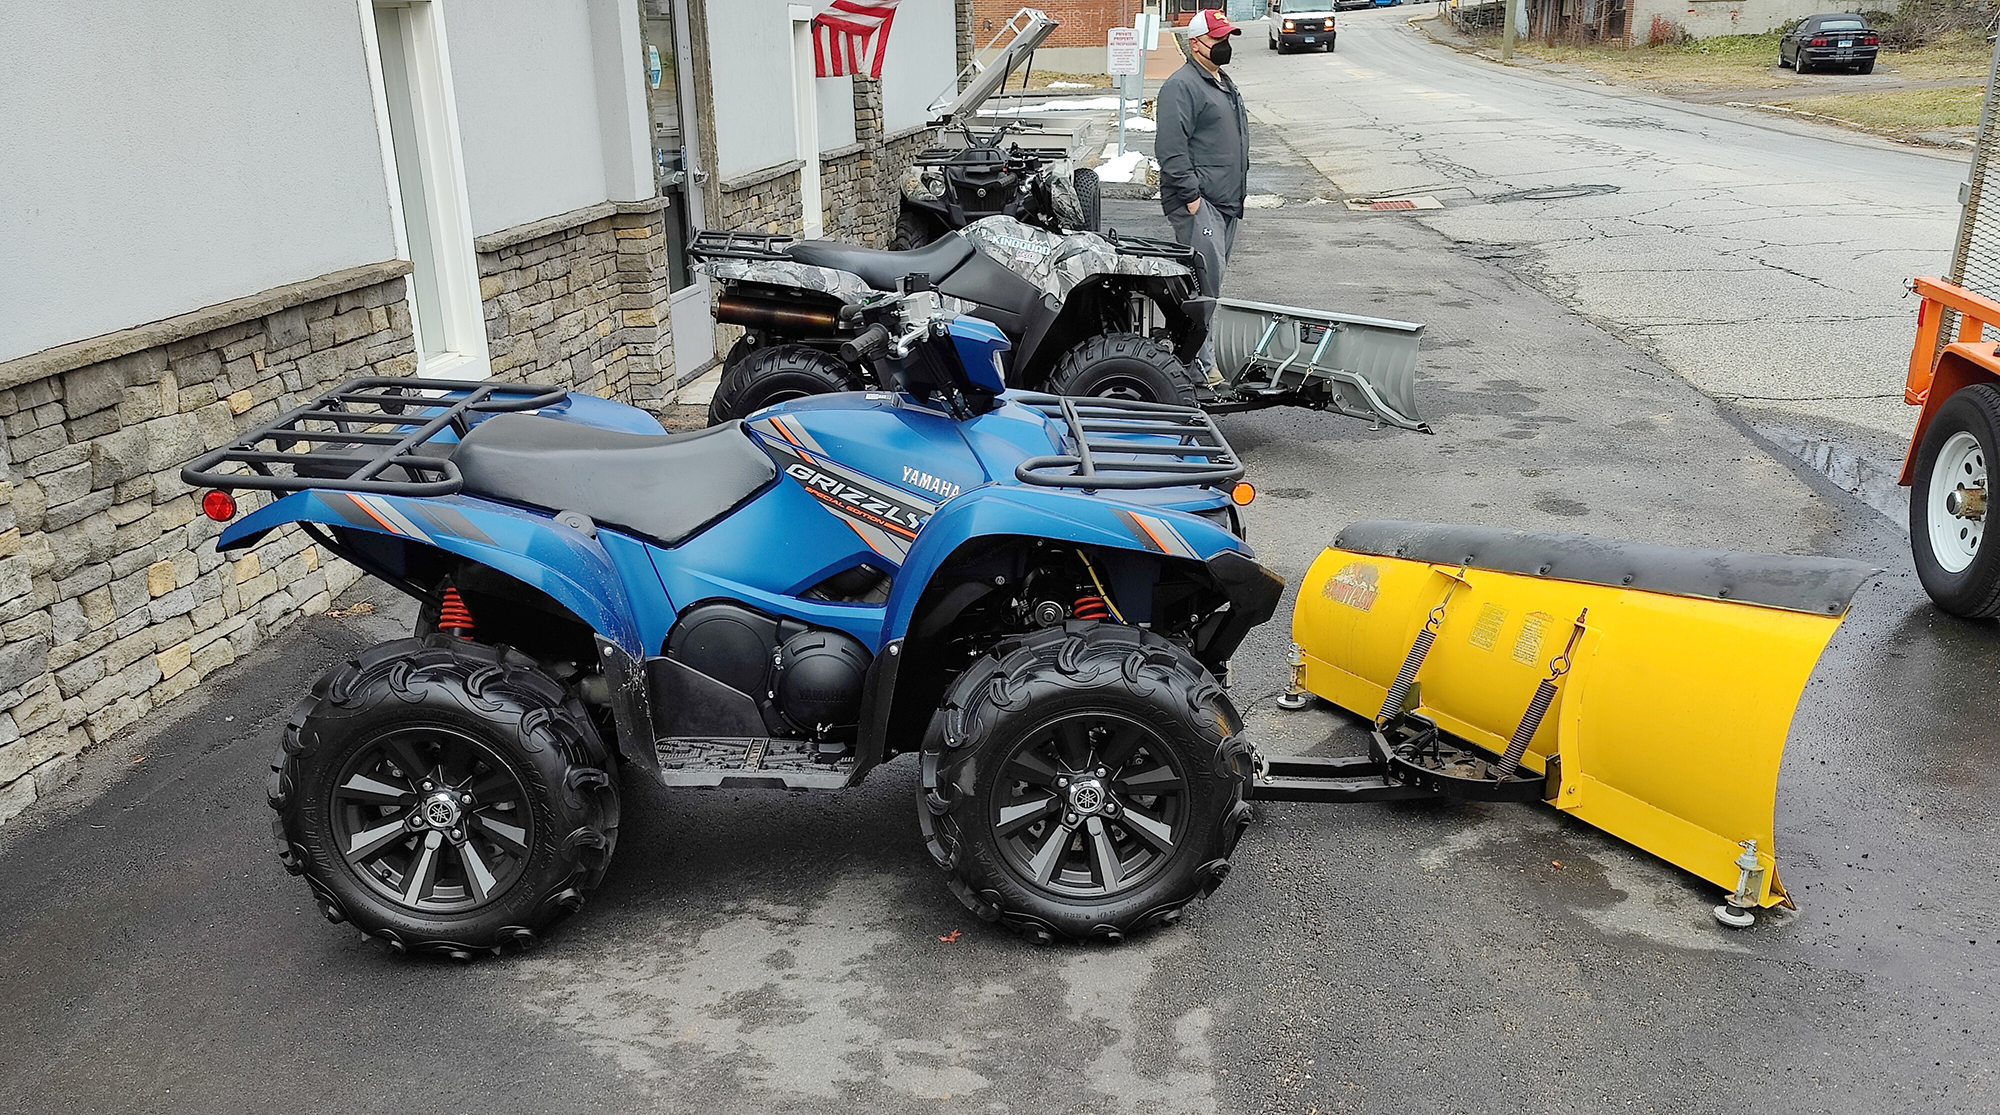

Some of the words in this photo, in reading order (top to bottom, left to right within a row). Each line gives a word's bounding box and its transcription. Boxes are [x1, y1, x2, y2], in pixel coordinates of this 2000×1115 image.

[902, 465, 960, 498] YAMAHA
[804, 486, 846, 508] SPECIAL
[845, 505, 885, 525] EDITION
